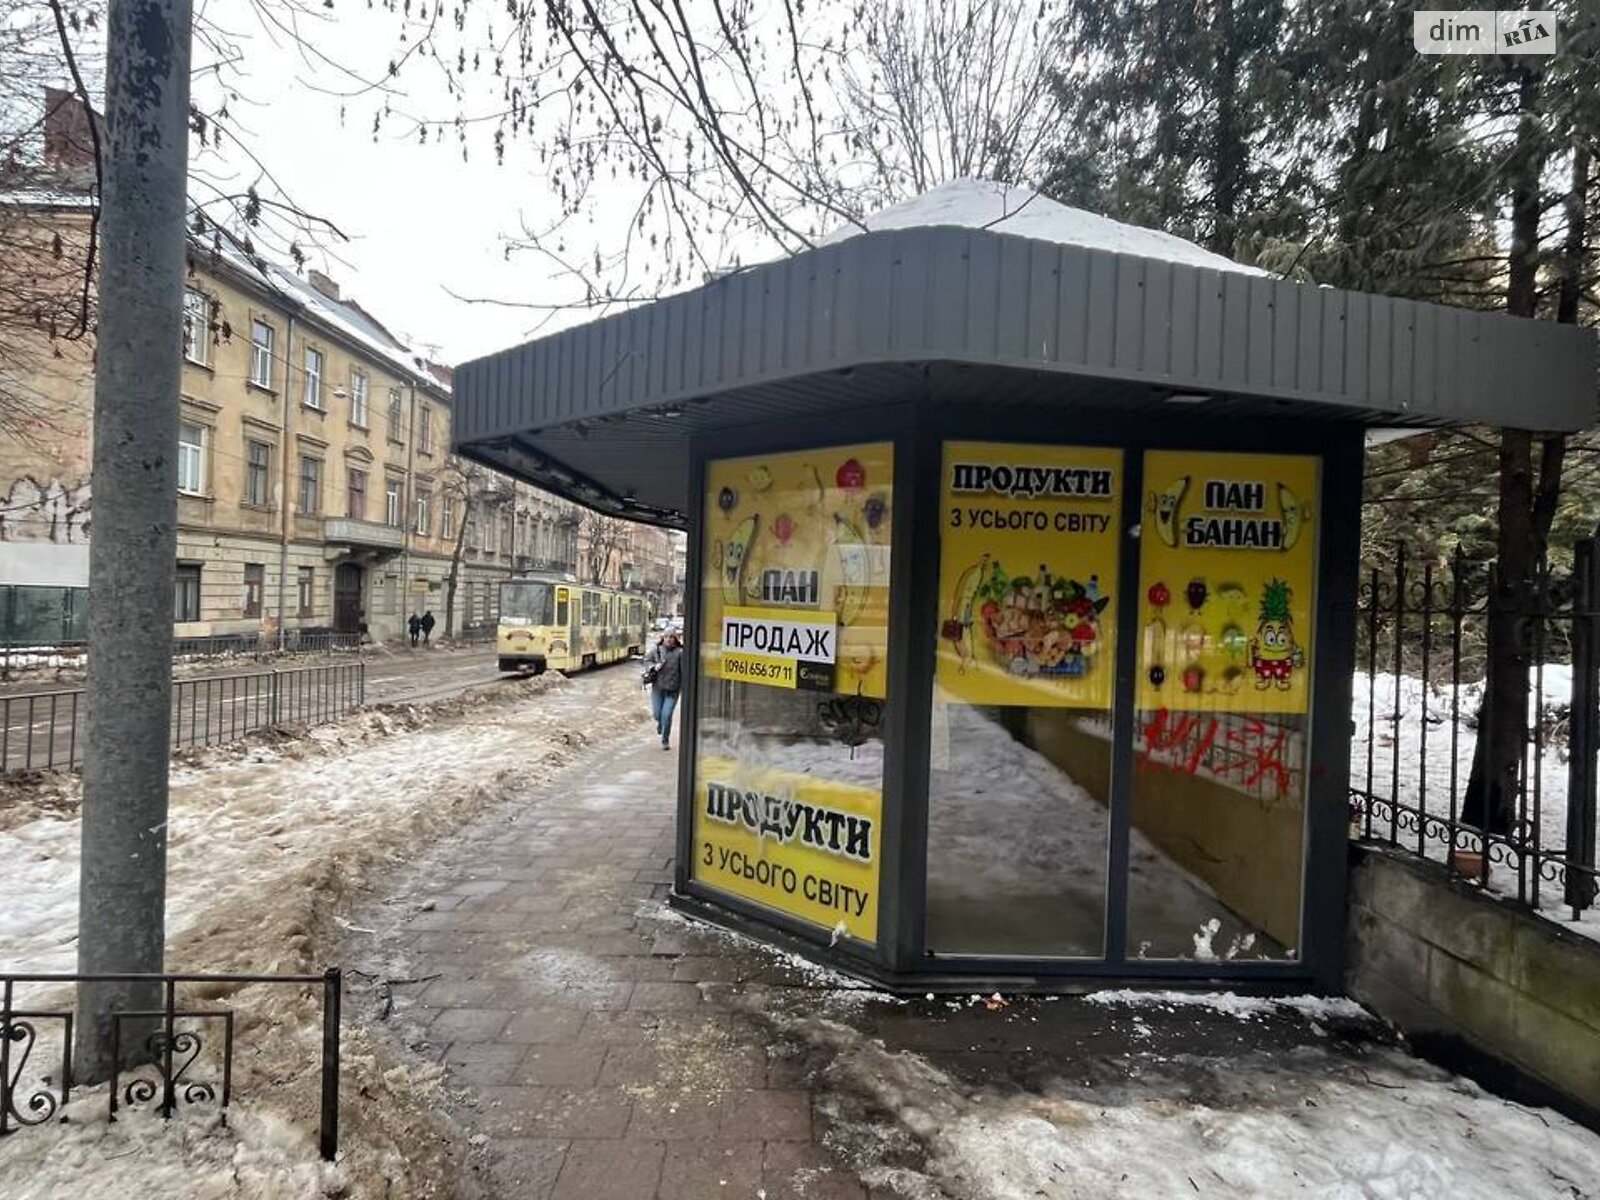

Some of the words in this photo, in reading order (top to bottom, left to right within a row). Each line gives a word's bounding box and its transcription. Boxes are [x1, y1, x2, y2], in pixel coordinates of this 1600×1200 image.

[953, 465, 1112, 496] ПРОДУКТИ
[1206, 481, 1264, 510] ПАН
[969, 509, 1048, 532] УСЬОГО
[1054, 511, 1110, 533] СВІТУ
[1187, 519, 1281, 548] БАНАН
[763, 569, 819, 603] ПАН
[726, 623, 830, 657] ПРОДАЖ
[749, 662, 768, 677] 656
[768, 664, 781, 679] 37
[783, 666, 792, 681] 11
[706, 783, 872, 860] ПРОДУКТИ
[719, 847, 797, 894] УСЬОГО
[804, 875, 869, 916] СВІТУ
